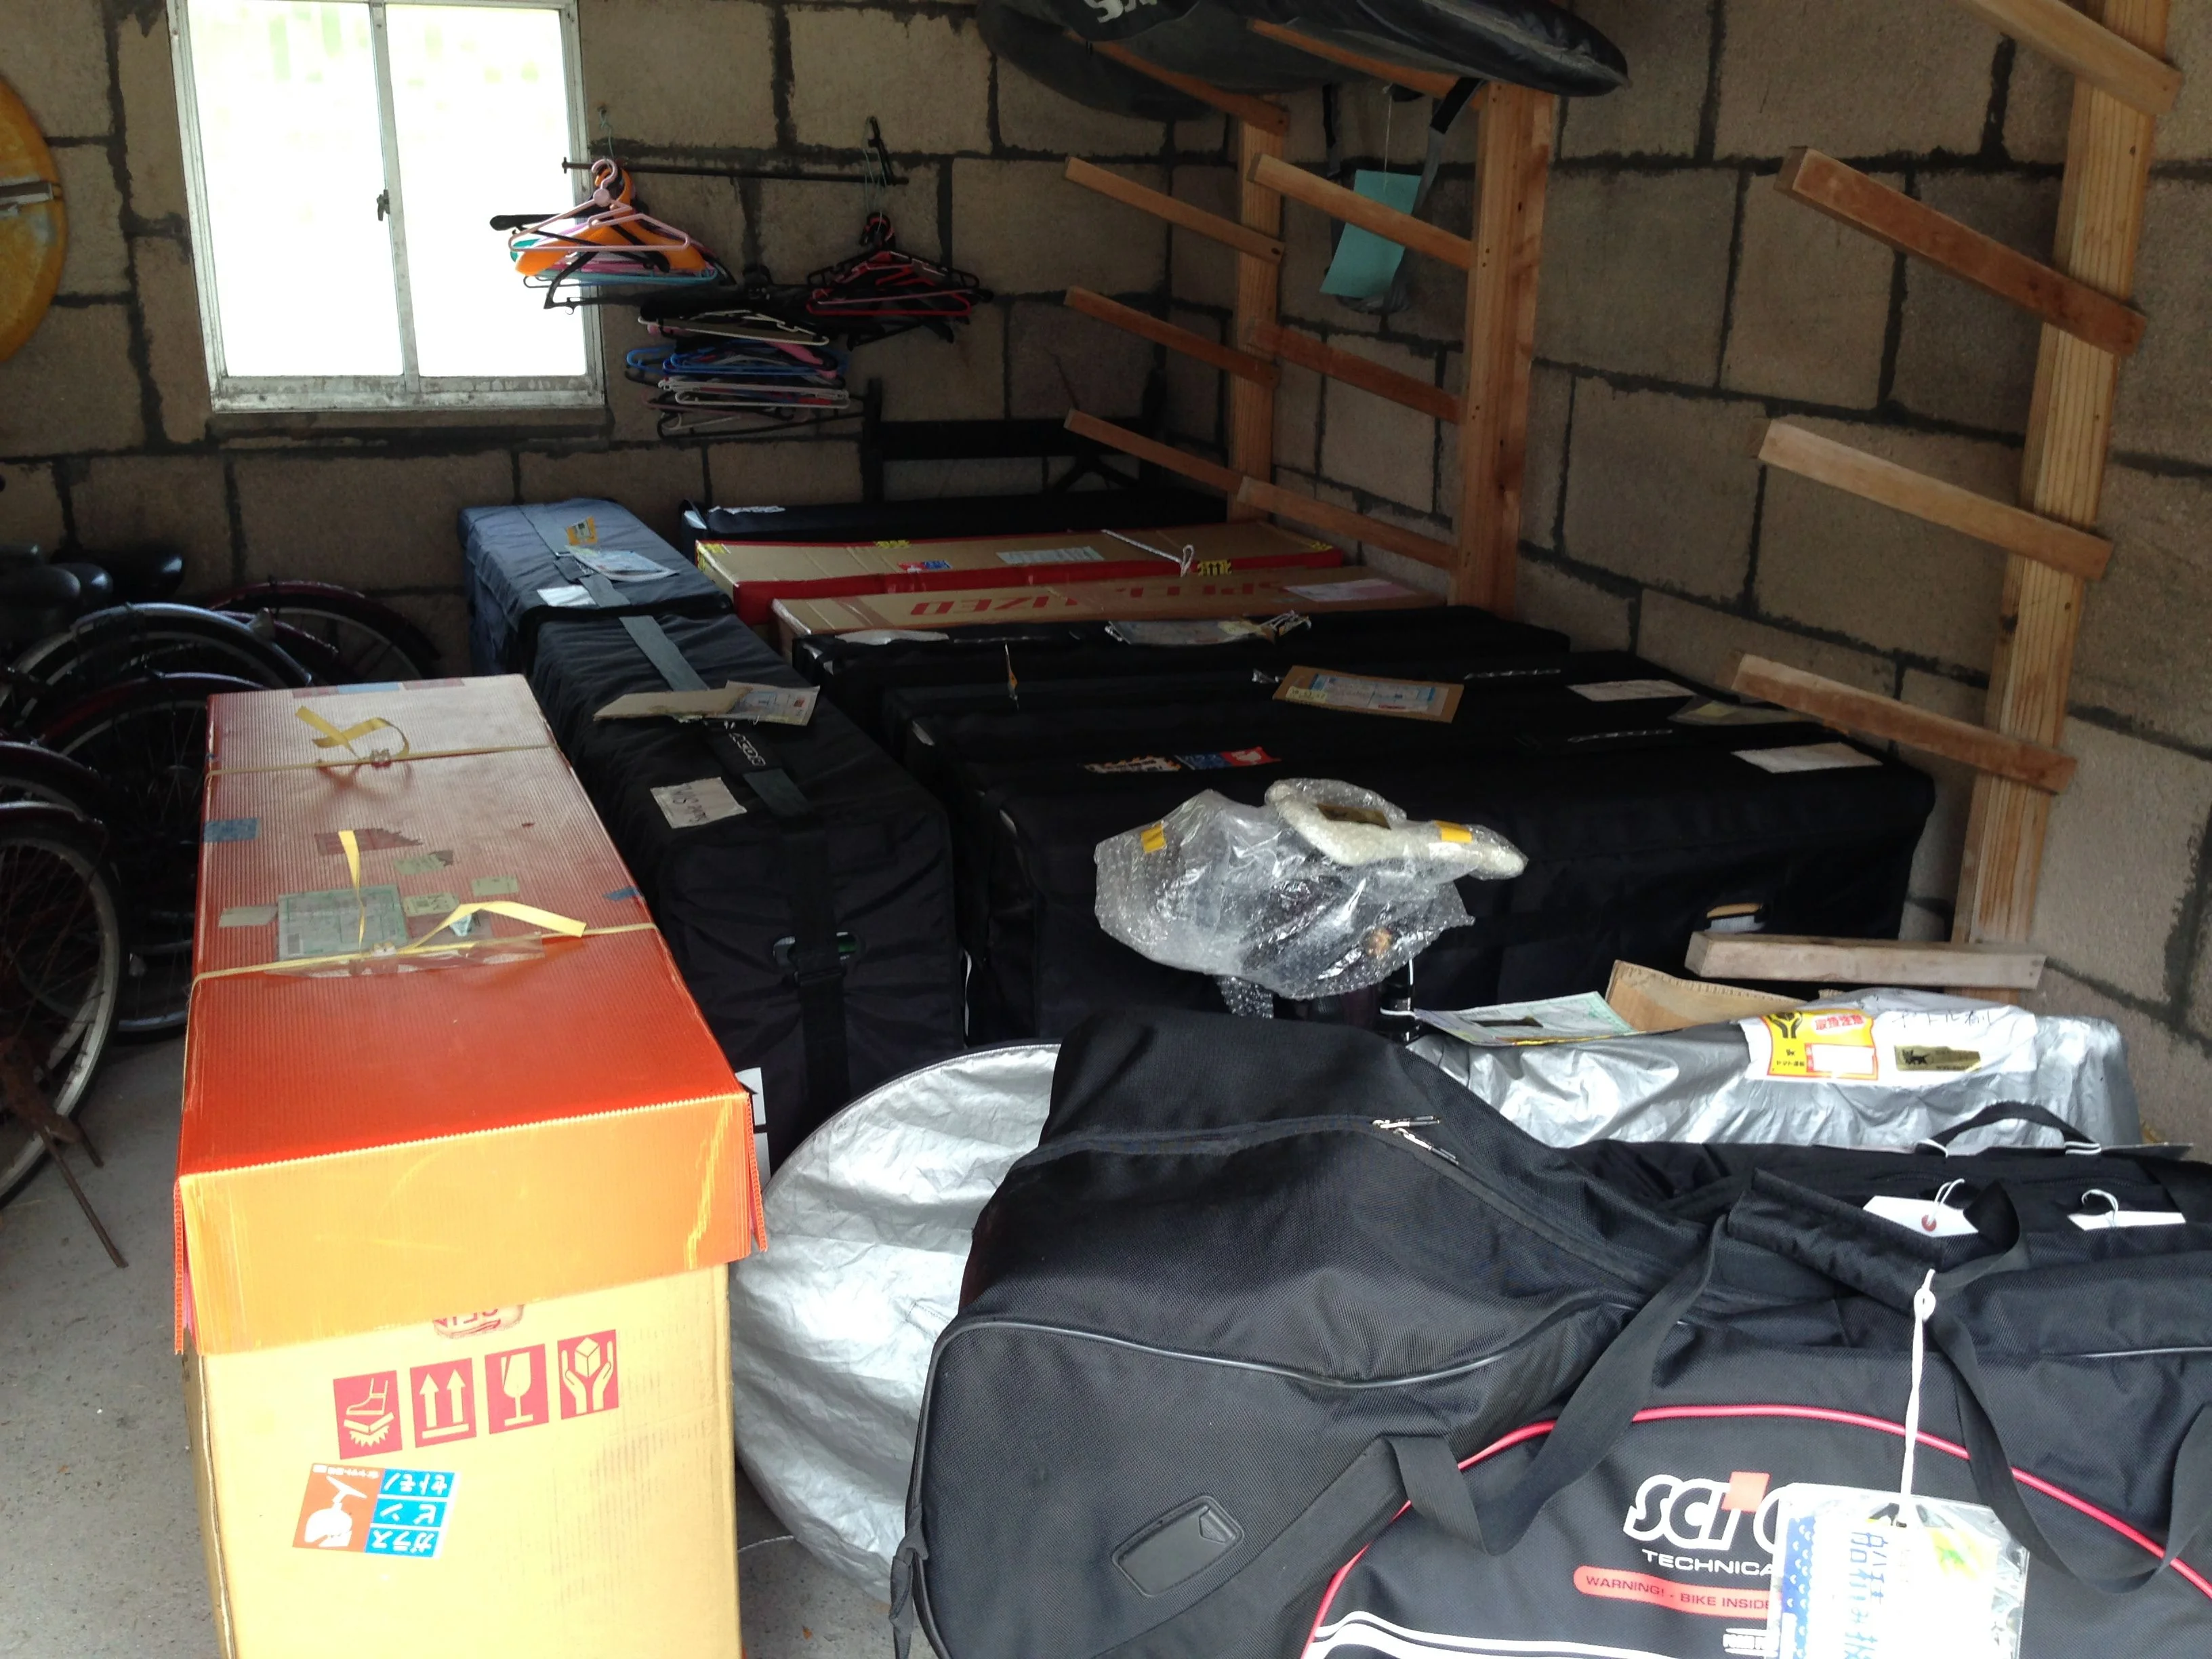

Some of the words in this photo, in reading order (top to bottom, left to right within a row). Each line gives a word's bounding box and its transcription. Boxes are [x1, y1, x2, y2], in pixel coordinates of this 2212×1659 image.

[383, 1472, 448, 1495] セトモノ
[380, 1502, 437, 1525] ビン
[371, 1530, 436, 1553] ガラス
[1586, 1574, 1665, 1597] WARNING!
[1680, 1593, 1717, 1607] BIKE
